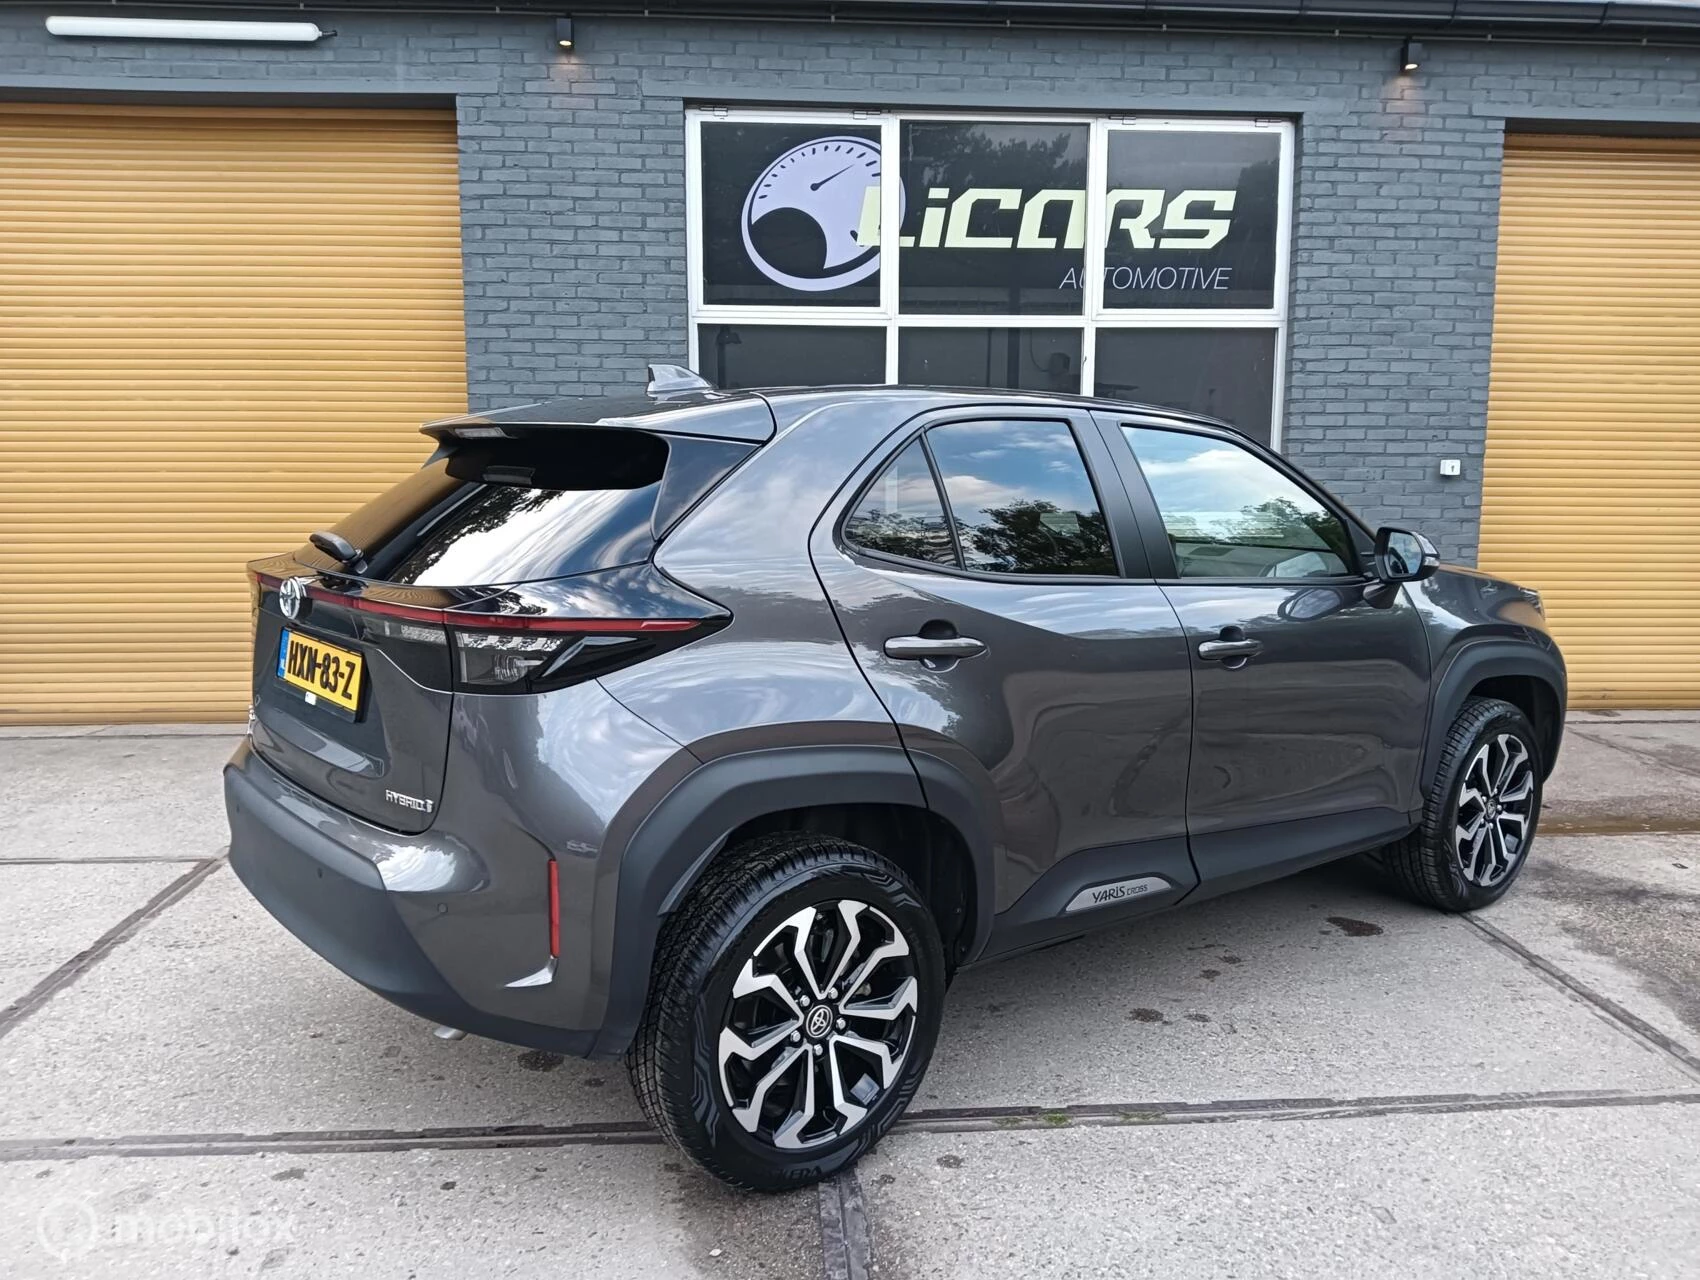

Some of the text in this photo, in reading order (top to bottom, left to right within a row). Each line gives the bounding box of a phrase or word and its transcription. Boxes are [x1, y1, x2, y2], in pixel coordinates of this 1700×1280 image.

[287, 640, 357, 700] HXN-83-Z
[385, 789, 425, 812] HYBRID
[1092, 884, 1148, 903] YARIS CROSS
